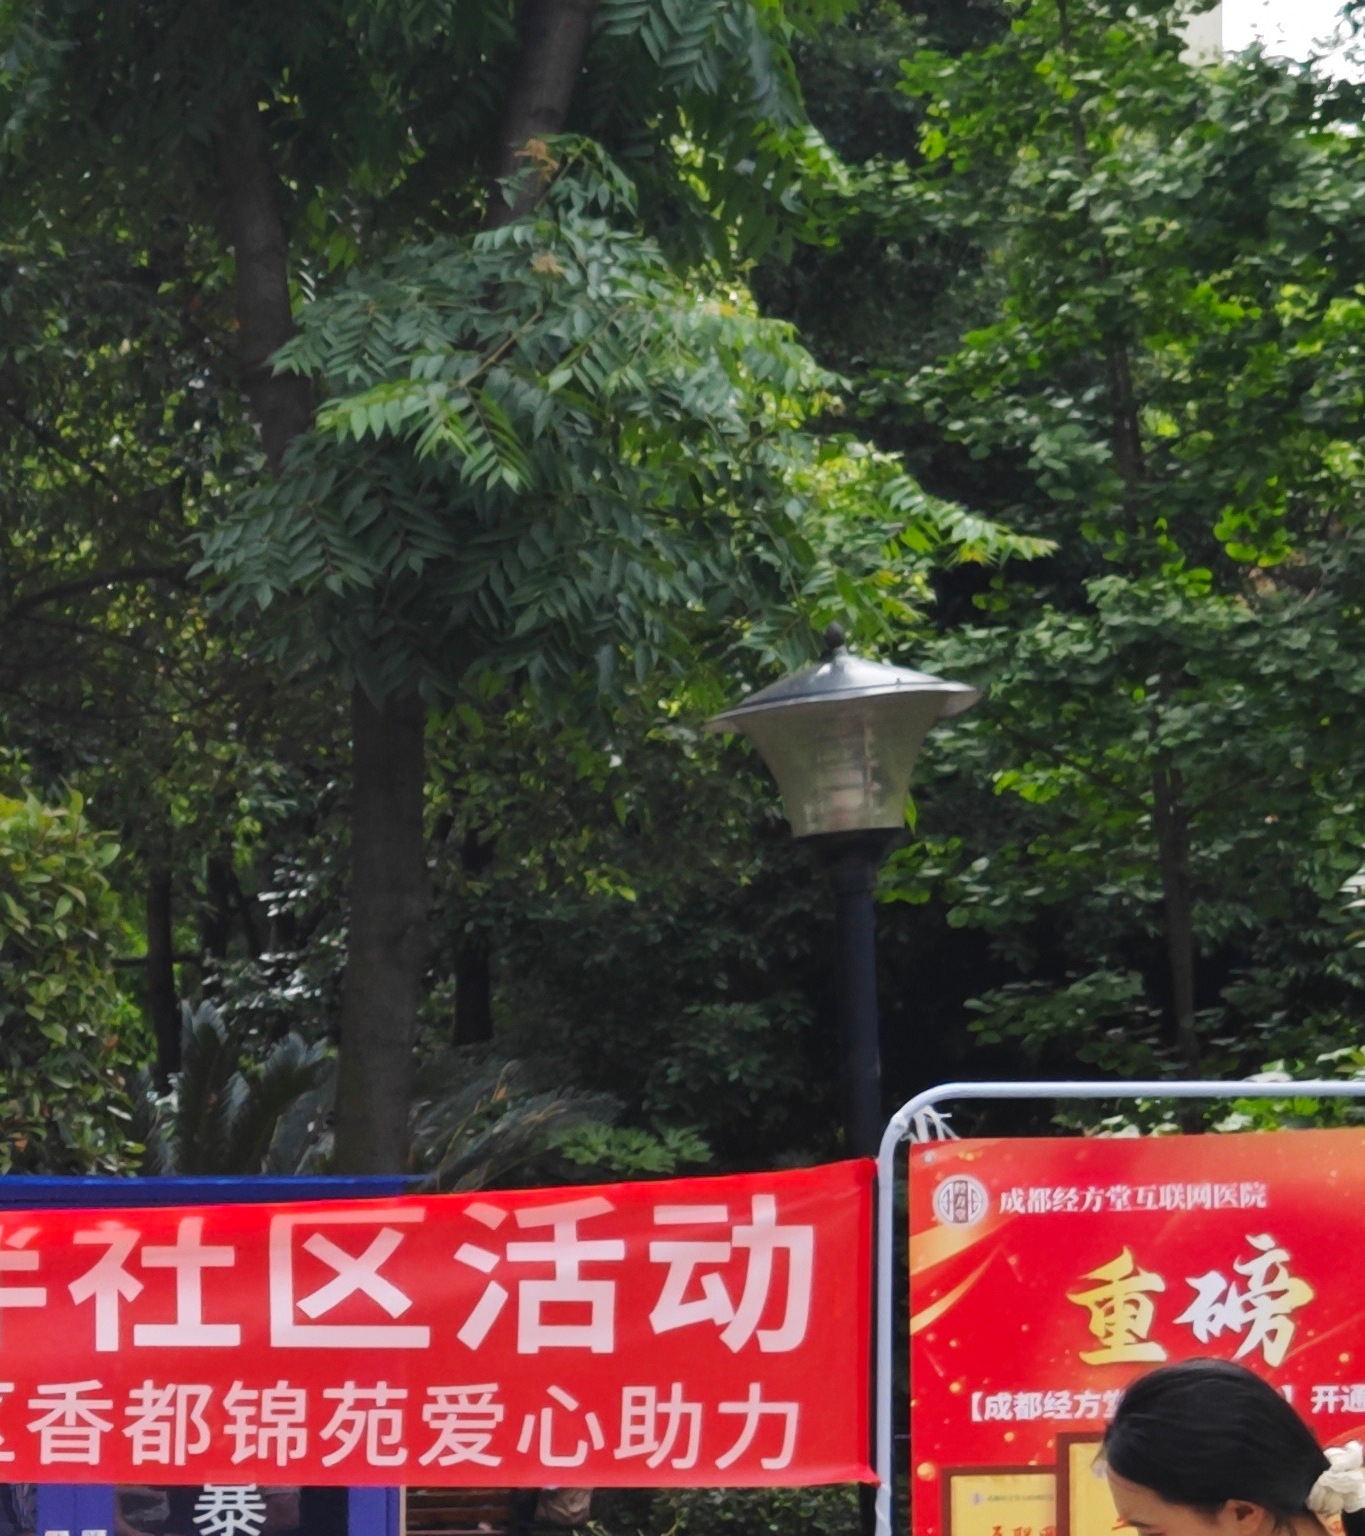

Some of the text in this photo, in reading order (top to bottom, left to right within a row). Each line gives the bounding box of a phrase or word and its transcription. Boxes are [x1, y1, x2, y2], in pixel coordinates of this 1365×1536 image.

[999, 1181, 1267, 1215] 成都经方堂互联网医院
[1066, 1233, 1315, 1368] 重磅
